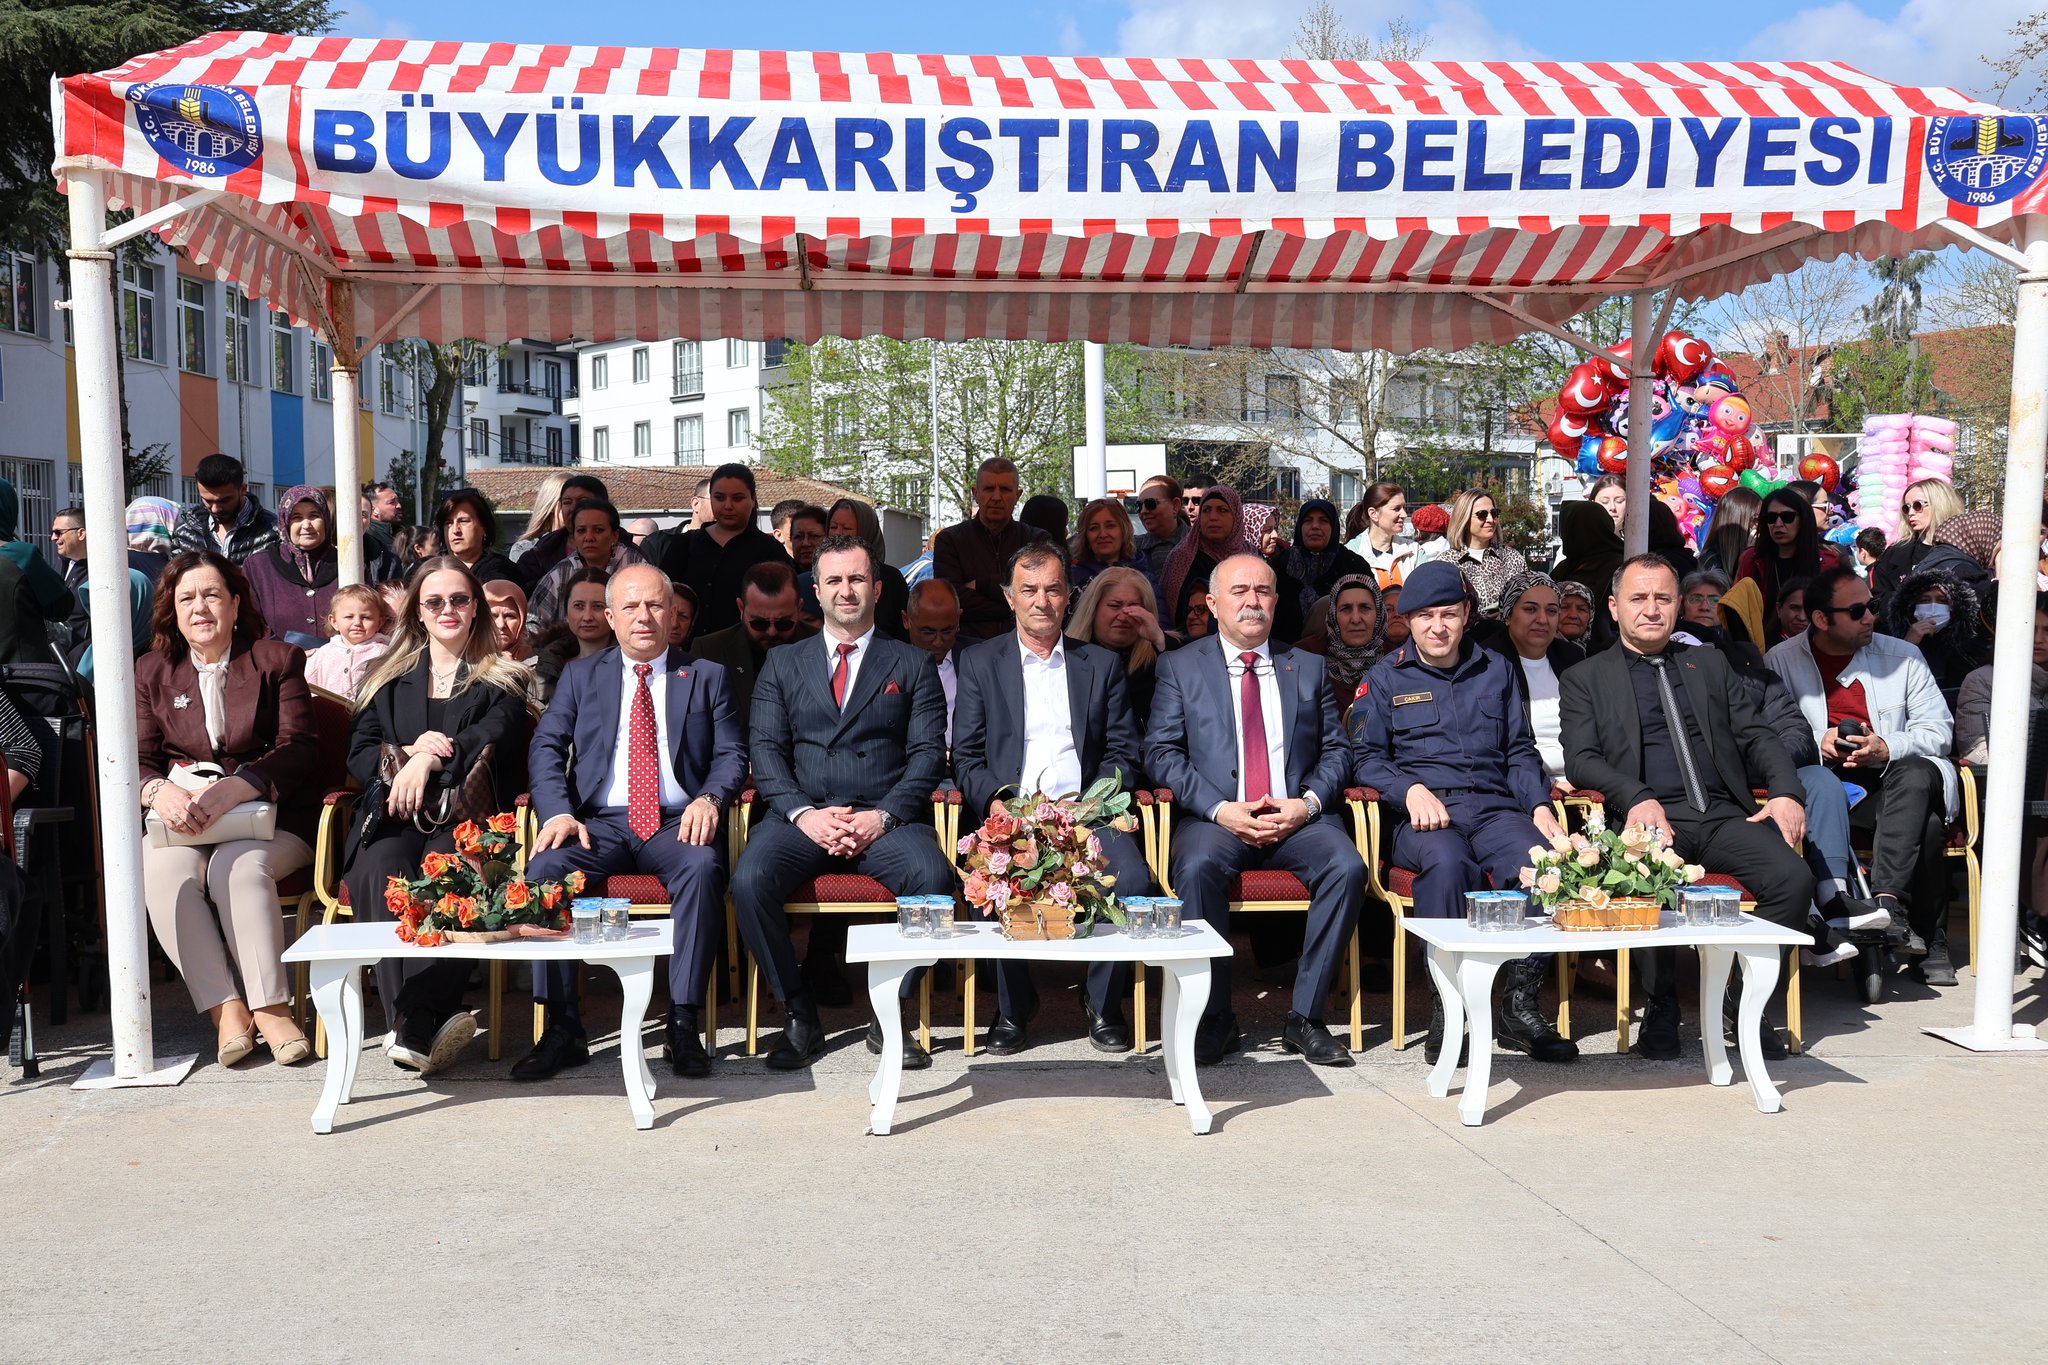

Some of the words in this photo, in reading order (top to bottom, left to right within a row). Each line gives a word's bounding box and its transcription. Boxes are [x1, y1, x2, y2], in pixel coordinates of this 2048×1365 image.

[145, 115, 160, 142] T.C.
[185, 157, 216, 174] 1986
[313, 94, 1300, 213] BÜYÜKKARIŞTIRAN
[1933, 158, 1947, 183] T.C.
[1966, 191, 1996, 204] 1986
